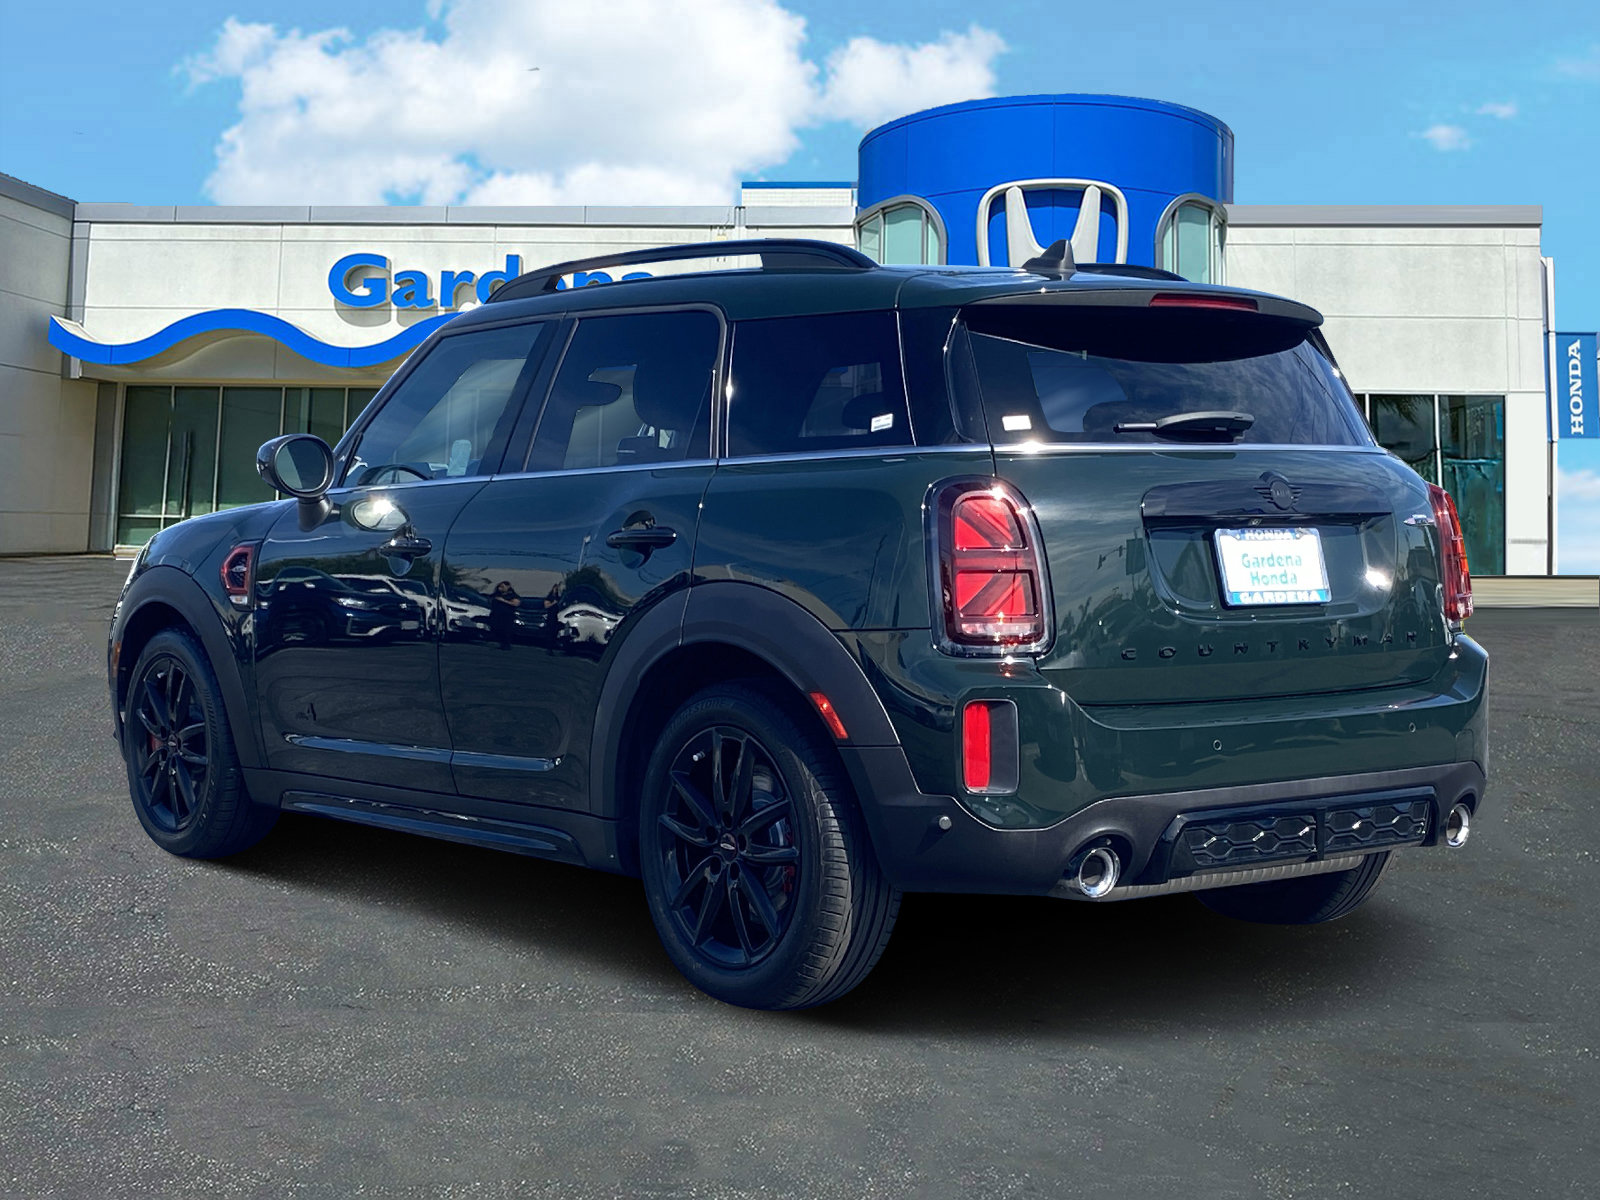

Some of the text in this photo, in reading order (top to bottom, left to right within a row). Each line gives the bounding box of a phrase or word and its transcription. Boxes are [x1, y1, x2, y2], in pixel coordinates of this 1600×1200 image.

[328, 252, 653, 307] Gard
[1568, 339, 1584, 435] HONDA
[1241, 552, 1302, 568] Gardena
[1250, 570, 1298, 586] Honda
[1240, 590, 1321, 605] GARDENA
[1121, 632, 1418, 661] COUNTRYMAN
